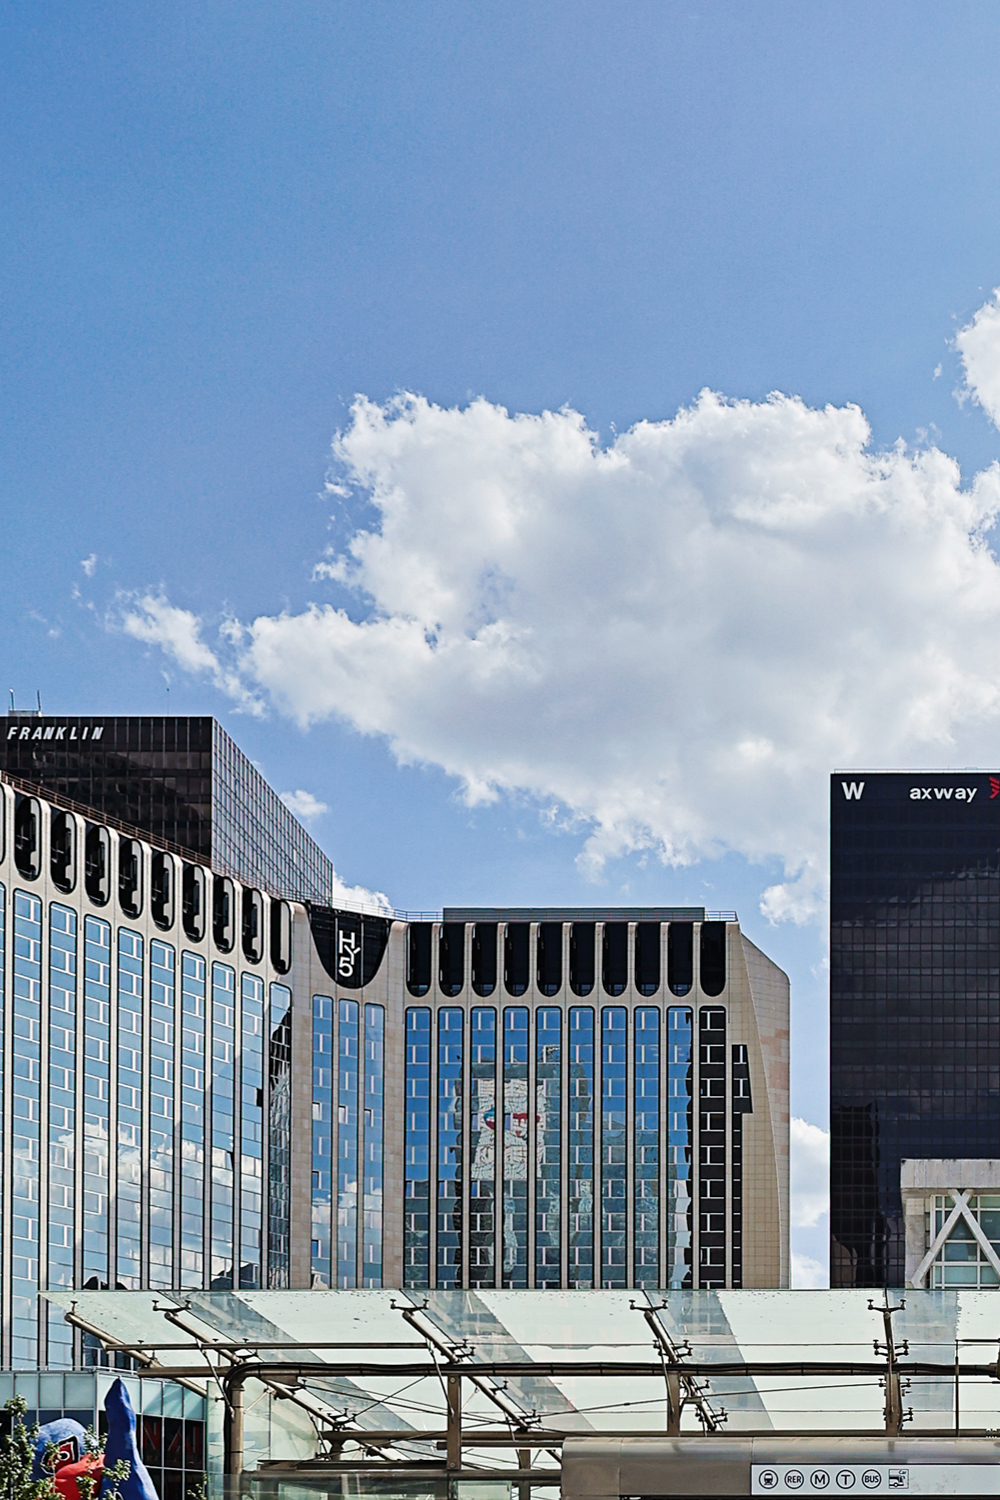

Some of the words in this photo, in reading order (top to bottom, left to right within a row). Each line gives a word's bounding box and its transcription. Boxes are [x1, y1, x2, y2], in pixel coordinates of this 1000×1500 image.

[6, 726, 104, 740] FRANKLIN
[841, 781, 865, 800] W
[909, 786, 978, 803] axway
[787, 1475, 802, 1484] RER
[814, 1474, 826, 1485] M
[840, 1474, 851, 1486] T
[864, 1475, 879, 1483] BUS
